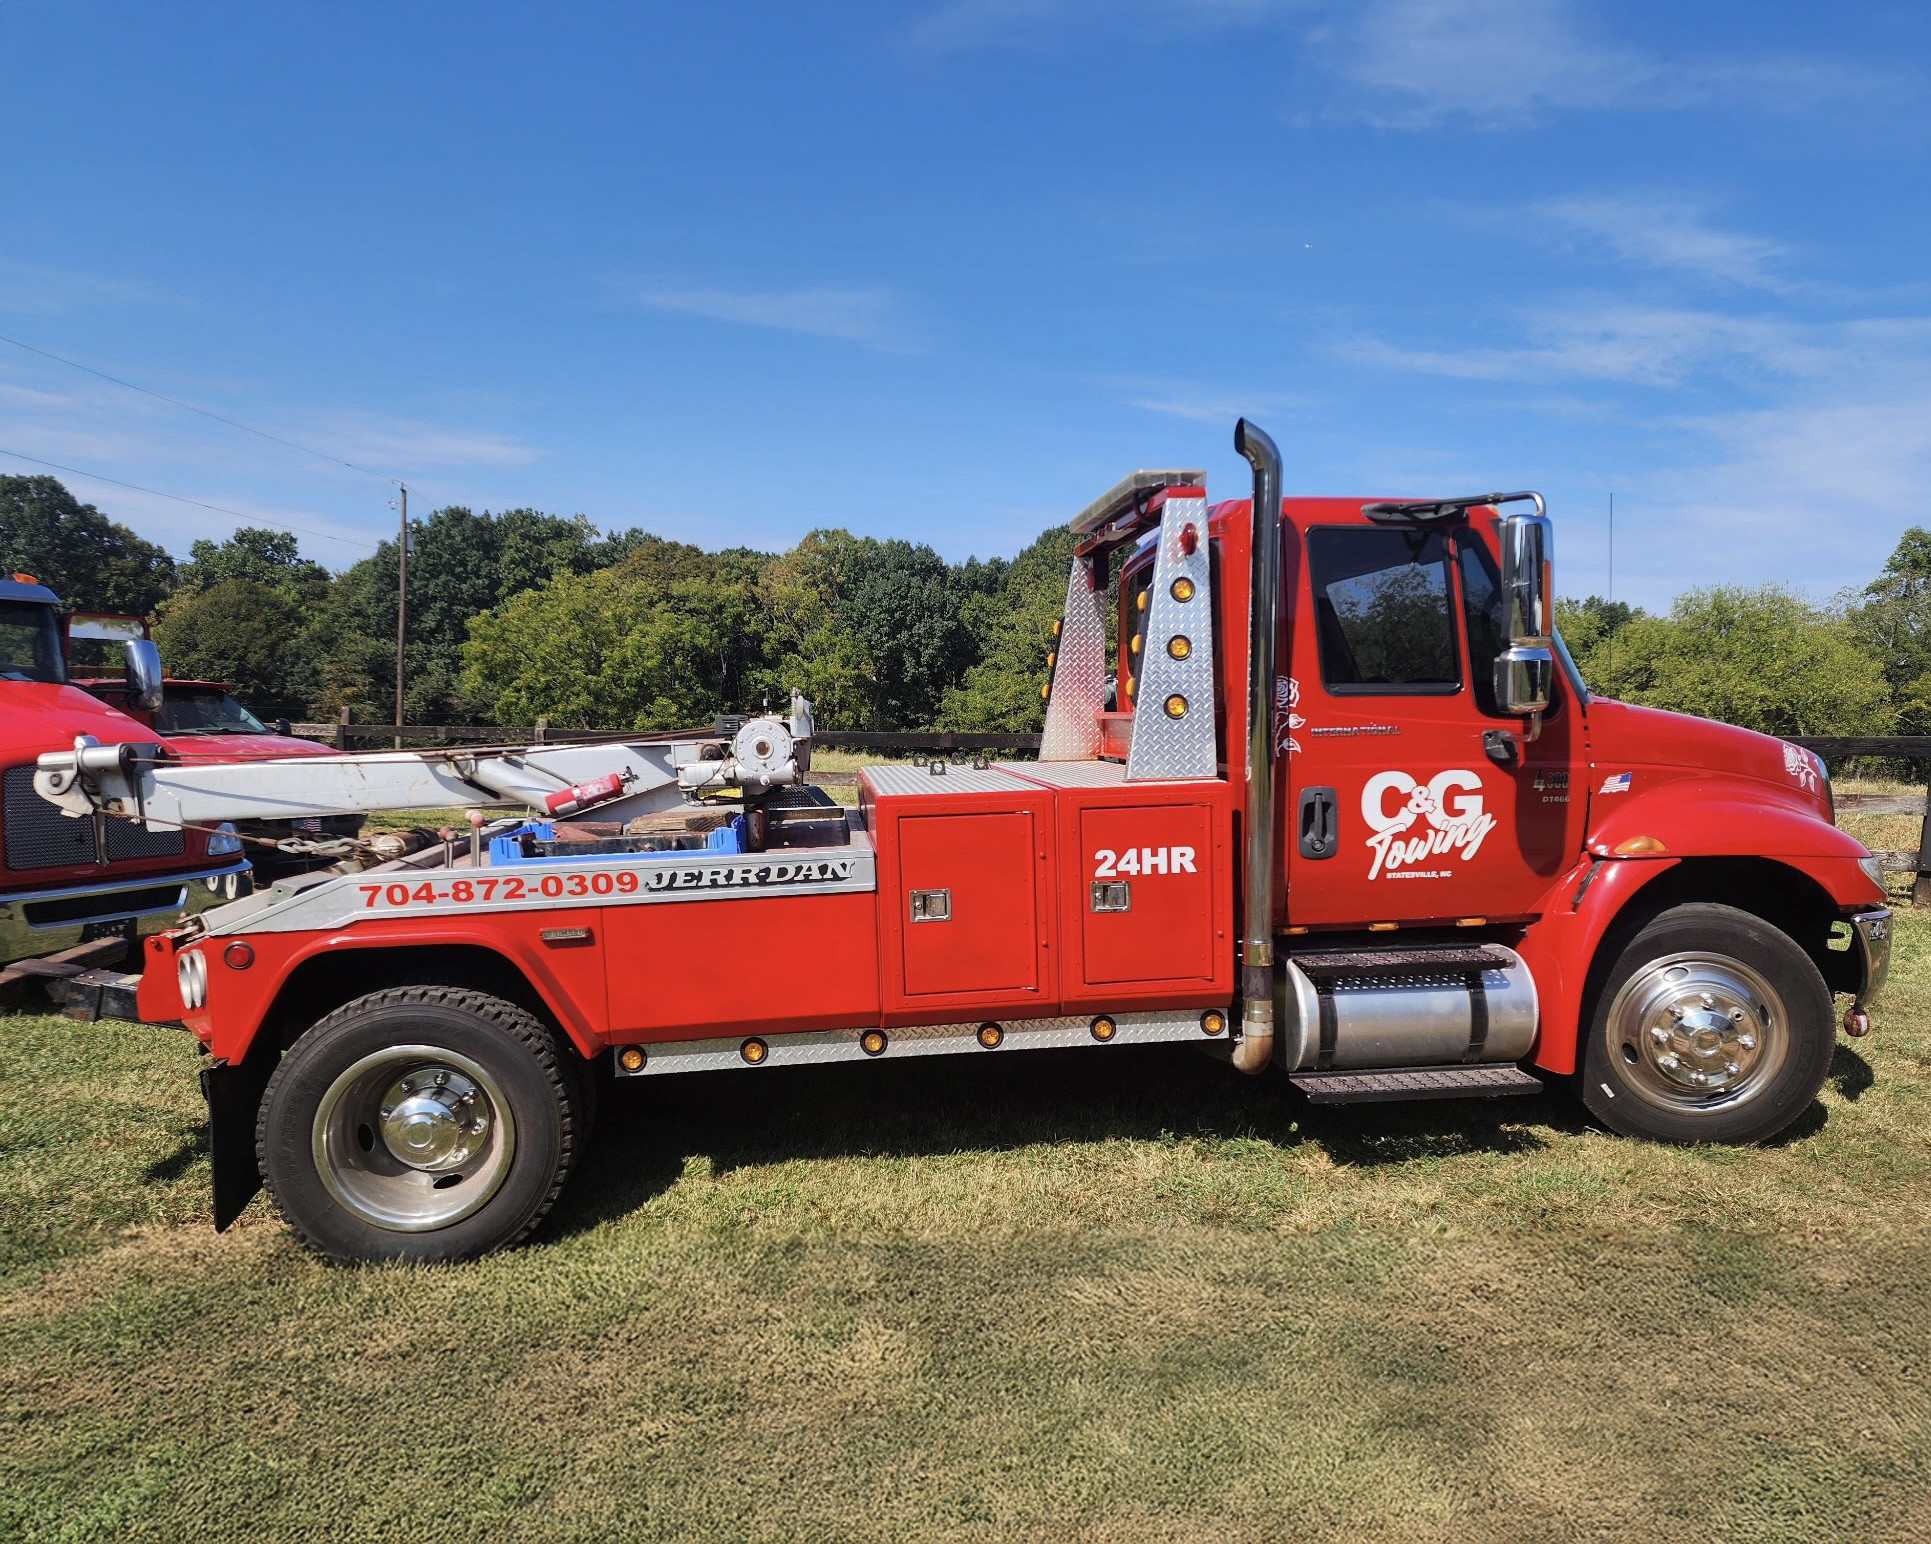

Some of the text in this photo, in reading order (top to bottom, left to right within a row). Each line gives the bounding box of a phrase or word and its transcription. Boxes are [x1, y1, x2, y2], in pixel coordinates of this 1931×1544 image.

[1310, 725, 1401, 738] INTERNATIONAL
[1533, 766, 1569, 791] 4300
[1361, 769, 1484, 832] C&G
[1094, 846, 1198, 878] 24HR
[1365, 812, 1498, 880] Towing
[359, 872, 639, 908] 704-872-0309
[644, 860, 856, 892] JERR-DAN
[1386, 870, 1439, 879] STATESVILLE,
